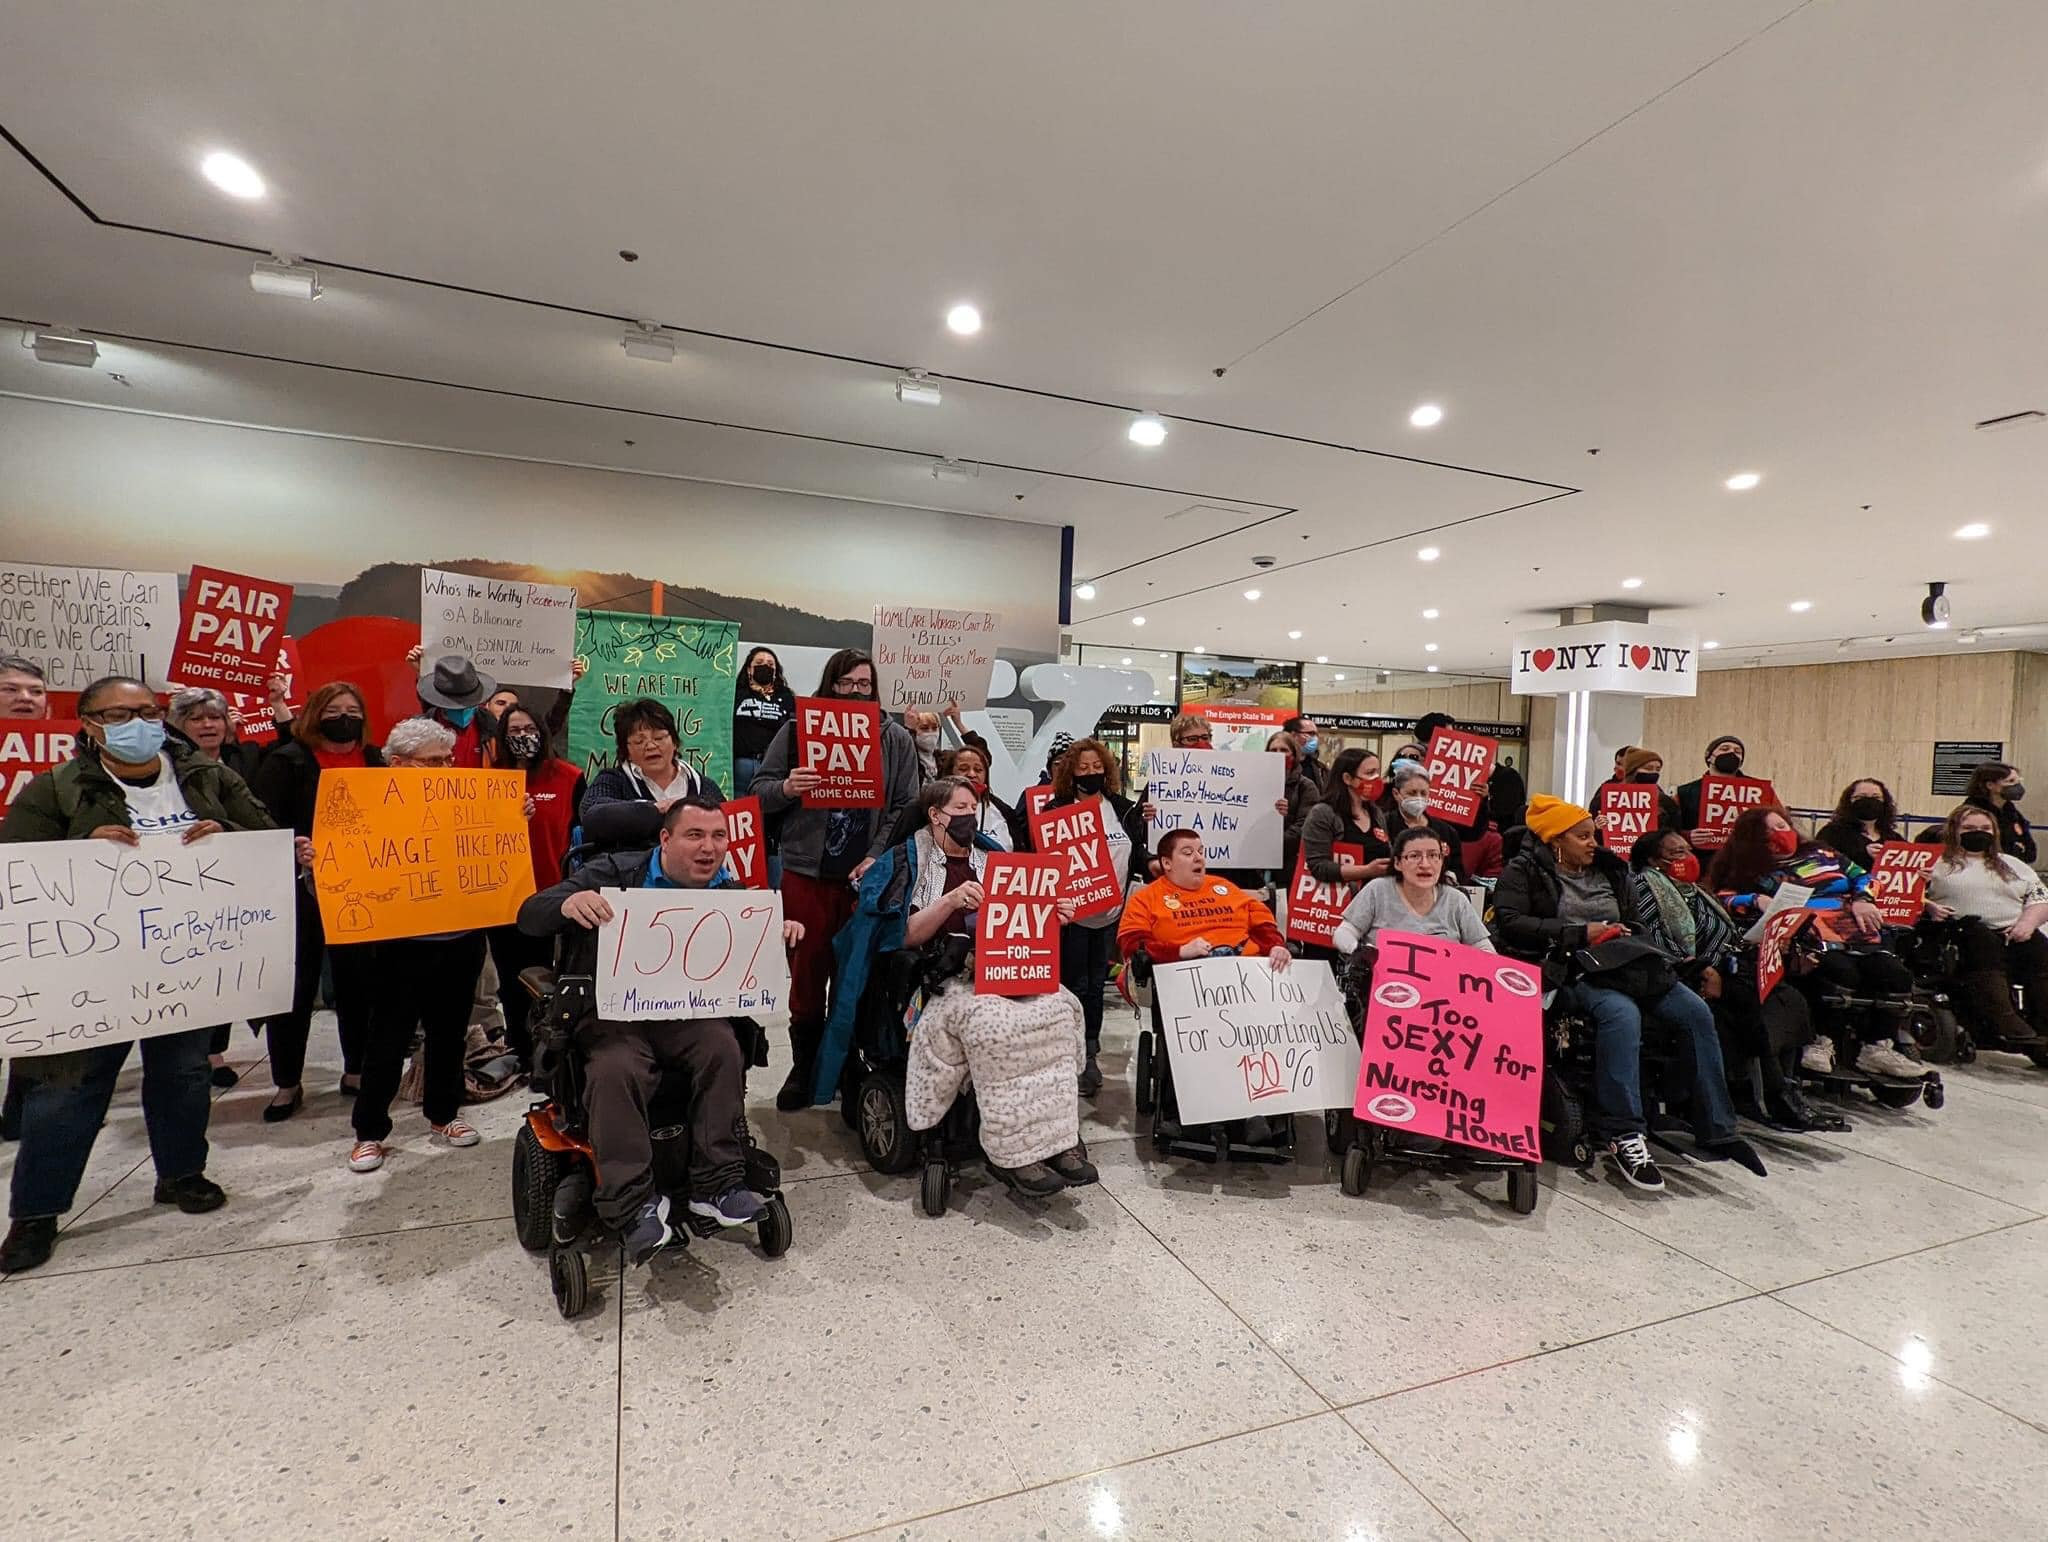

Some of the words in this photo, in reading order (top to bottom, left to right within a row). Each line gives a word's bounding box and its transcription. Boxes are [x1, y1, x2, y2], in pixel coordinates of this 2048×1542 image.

[0, 571, 70, 598] gether
[76, 570, 111, 601] We
[121, 572, 158, 604] Can
[197, 579, 280, 620] FAIR
[423, 570, 461, 596] Who's
[467, 584, 481, 598] the
[487, 582, 522, 608] Worthy
[0, 598, 35, 622] ove
[51, 598, 151, 630] Mountains,
[472, 608, 523, 628] Billionaire
[0, 623, 47, 649] Alone
[54, 624, 83, 650] We
[188, 612, 274, 654] PAY
[455, 636, 473, 657] My
[531, 641, 556, 655] Home
[966, 649, 988, 665] MORE
[1519, 650, 1531, 673] I
[1556, 643, 1606, 670] NY
[1618, 643, 1629, 668] I
[1651, 646, 1690, 673] NY
[212, 652, 241, 667] FOR
[475, 653, 494, 666] Care
[502, 656, 530, 667] Worker
[906, 665, 932, 679] ABOUT
[940, 666, 953, 678] THE
[181, 662, 222, 679] HOME
[224, 670, 263, 686] CARE
[604, 673, 629, 695] WE
[637, 674, 666, 696] ARE
[673, 677, 698, 696] THE
[259, 707, 275, 717] FO
[805, 708, 870, 739] FAIR
[1105, 706, 1127, 714] WAN
[1140, 707, 1161, 716] BLDG
[1218, 710, 1241, 720] Empire
[1242, 711, 1260, 720] State
[1260, 712, 1274, 721] Trail
[244, 720, 275, 735] HOME
[1371, 720, 1397, 728] MUSEUM
[0, 732, 76, 763] AIR
[806, 741, 871, 772] PAY
[1434, 736, 1487, 765] FAIR
[1151, 752, 1177, 775] NEW
[1180, 752, 1203, 776] YORK
[1211, 765, 1236, 778] NEEDS
[1428, 759, 1481, 791] PAY
[383, 778, 404, 804] A
[423, 777, 477, 803] BONUS
[487, 779, 518, 801] PAYS
[830, 776, 853, 785] FOR
[1708, 783, 1762, 803] FAIR
[810, 789, 842, 799] HOME
[844, 789, 875, 799] CARE
[1438, 788, 1457, 800] FOR
[1607, 791, 1651, 809] FAIR
[422, 806, 440, 832] A
[454, 805, 496, 825] BILL
[1427, 798, 1445, 809] OME
[1444, 802, 1470, 816] CARE
[1706, 804, 1748, 825] PA
[728, 811, 754, 843] IR
[1040, 810, 1097, 848] FAIR
[1152, 810, 1182, 830] NOT
[1192, 813, 1204, 830] A
[1212, 812, 1239, 831] NEW
[1607, 812, 1651, 833] PAY
[320, 841, 339, 872] A
[363, 837, 436, 870] WAGE
[455, 834, 491, 858] HIKE
[495, 832, 527, 857] PAYS
[1610, 845, 1632, 854] HOME
[1880, 849, 1932, 868] FAIR
[95, 848, 236, 910] YORK
[400, 870, 443, 897] THE
[458, 861, 509, 890] BILLS
[990, 865, 1060, 897] FAIR
[1071, 876, 1093, 892] FOR
[1876, 870, 1921, 894] PAY
[1087, 885, 1114, 903] CARE
[1883, 896, 1900, 905] FOR
[985, 903, 1055, 939] PAY
[1172, 905, 1234, 920] FREEDOM
[1290, 917, 1317, 933] HOME
[1309, 907, 1329, 919] FOR
[1889, 908, 1911, 917] CARE
[0, 913, 120, 963] EEDS
[612, 906, 774, 991] 150%
[1007, 945, 1030, 959] FOR
[985, 965, 1018, 981] HOME
[1021, 965, 1051, 980] CARE
[1175, 961, 1256, 1008] Thank
[1256, 962, 1306, 1003] You
[0, 984, 40, 1018] ot
[71, 990, 107, 1008] a
[131, 976, 202, 1000] New
[601, 992, 617, 1013] of
[623, 987, 686, 1014] Minimum
[687, 988, 722, 1013] Wage
[737, 993, 757, 1009] Fair
[760, 988, 776, 1011] Pay
[5, 1001, 189, 1052] Stadium
[1420, 998, 1479, 1030] Too
[1174, 1016, 1209, 1054] For
[1218, 1009, 1322, 1052] Supporting
[1317, 1011, 1347, 1045] Us
[1381, 1015, 1484, 1071] SEXY
[1493, 1044, 1537, 1081] for
[1236, 1048, 1313, 1103] 150%
[1427, 1057, 1450, 1078] a
[1365, 1062, 1486, 1124] Nursing
[1444, 1109, 1540, 1160] HOME!
